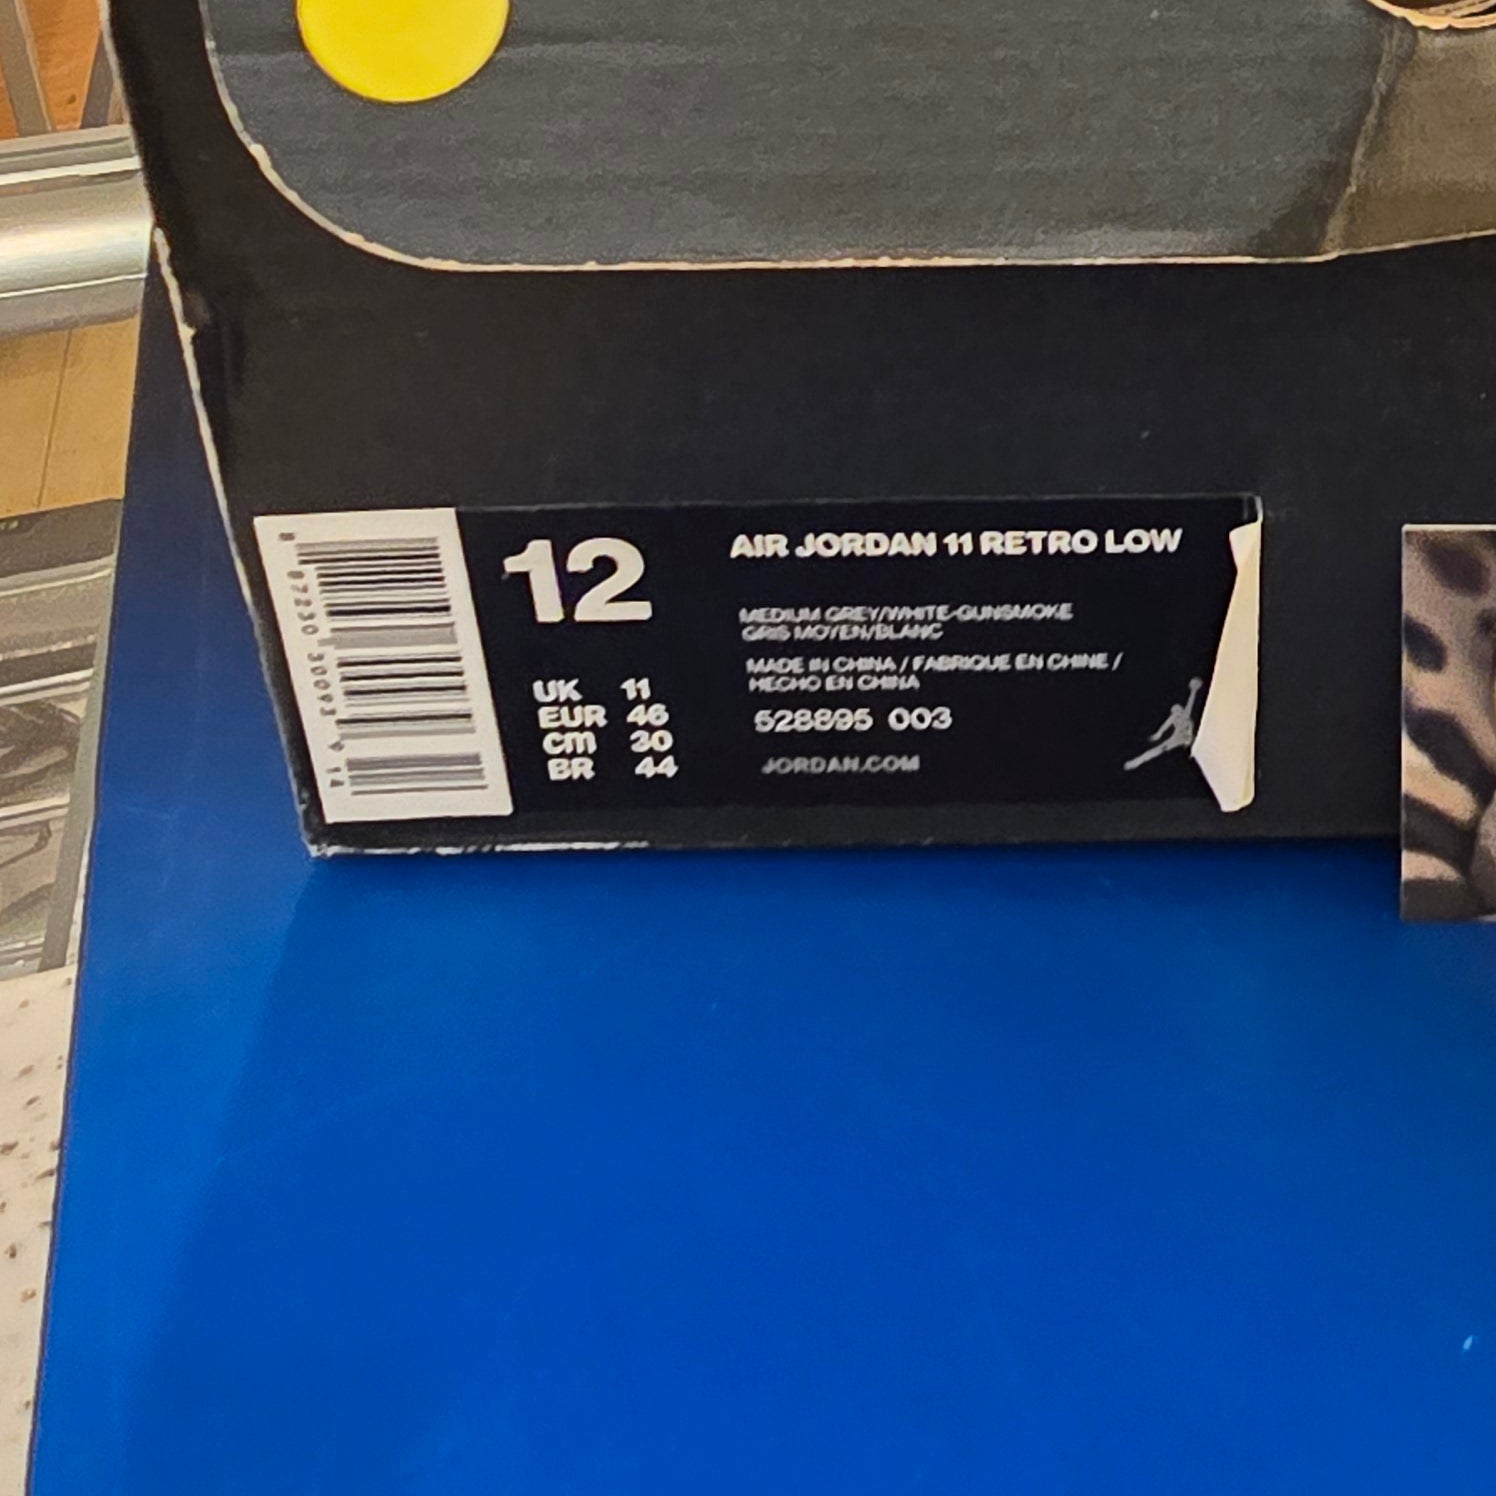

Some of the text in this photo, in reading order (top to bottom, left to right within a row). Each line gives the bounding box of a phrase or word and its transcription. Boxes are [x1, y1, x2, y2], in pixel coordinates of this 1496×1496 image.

[729, 527, 1184, 559] AIR JORDAN 11 RETRO LOW
[503, 537, 653, 623] 12
[738, 607, 822, 623] MEDIUM
[746, 657, 805, 674] MADE
[808, 657, 830, 673] IN
[832, 656, 897, 673] CHINA
[912, 654, 1011, 672] FABRIQUE
[1014, 653, 1044, 671] EN
[1046, 652, 1109, 671] CHINE
[532, 677, 651, 703] UK 11
[824, 675, 854, 691] EN
[856, 673, 921, 691] CHINA
[537, 703, 670, 729] EUR 46
[753, 706, 953, 733] 528895 003
[547, 754, 679, 781] BR 44
[760, 755, 921, 775] JORDAN.COM
